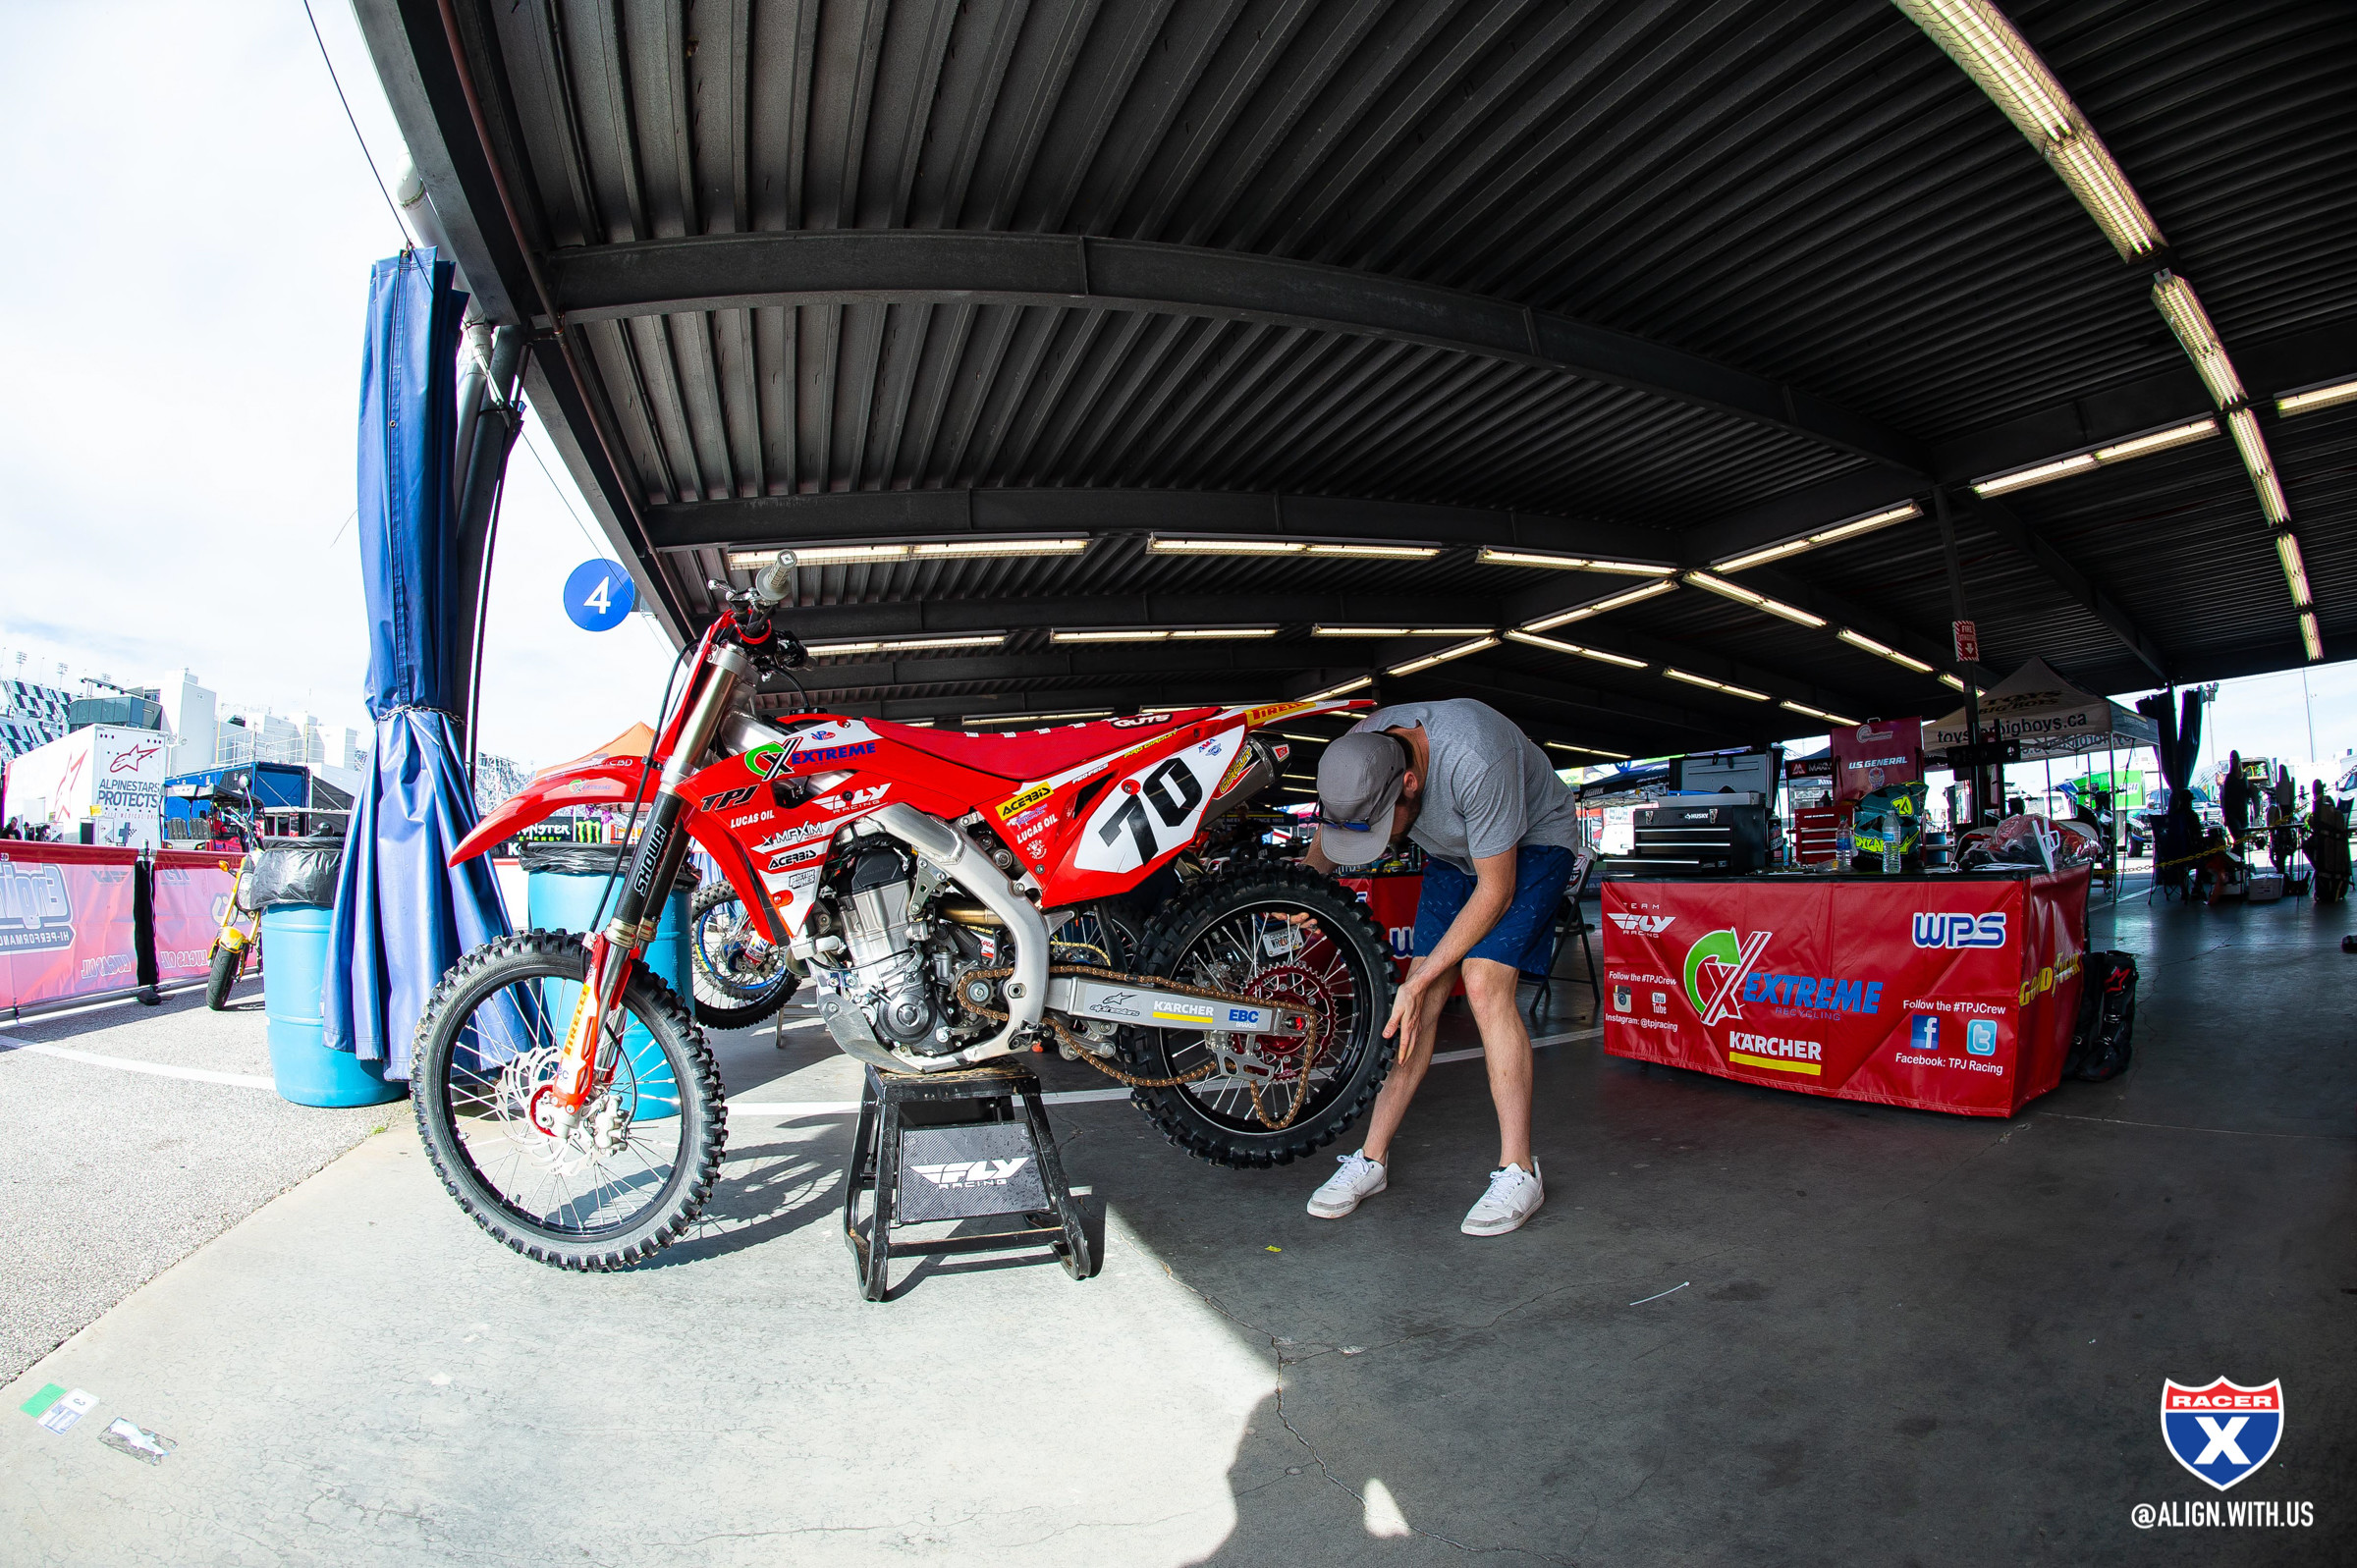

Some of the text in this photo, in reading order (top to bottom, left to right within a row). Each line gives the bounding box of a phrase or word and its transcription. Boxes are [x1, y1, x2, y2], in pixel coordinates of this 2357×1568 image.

[583, 576, 611, 614] 4
[1113, 713, 1171, 730] GUTS
[1124, 729, 1178, 758] PRO CIRCUIT
[792, 742, 876, 765] EXTREME
[1864, 756, 1908, 768] GENERAL
[99, 779, 160, 793] ALPINESTARS
[99, 790, 158, 808] PROTECTS
[700, 784, 761, 813] TPJ
[832, 799, 881, 815] RACING
[1002, 787, 1051, 817] ACERBIS
[1891, 795, 1914, 817] 70
[730, 810, 776, 829] LUCAS OIL
[1098, 757, 1203, 867] 70
[776, 821, 824, 843] MAXIM
[1016, 822, 1043, 844] LUCAS
[1044, 814, 1059, 829] OIL
[634, 823, 668, 897] SHOWA
[769, 850, 817, 870] ACERBIS
[789, 870, 815, 883] PISTON
[792, 877, 815, 889] BONES
[1607, 912, 1676, 933] FLY
[1912, 912, 2006, 948] WPS
[1609, 970, 1677, 986] Follow the #TPJCrew
[1654, 993, 1665, 1002] You
[1742, 972, 1884, 1014] EXTREME
[1153, 1000, 1215, 1016] KÄRCHER
[1229, 1008, 1260, 1023] EBC
[1653, 1003, 1667, 1014] Tube
[1776, 1006, 1841, 1021] RECYCLING
[1903, 1000, 2006, 1014] Follow the #TPJCrew
[1606, 1014, 1678, 1033] Instagram: @tpjracing
[1729, 1031, 1822, 1060] KÄRCHER
[1895, 1053, 2003, 1076] Facebook: TPJ Racing
[909, 1157, 1030, 1184] FLY
[938, 1179, 1008, 1190] RACING
